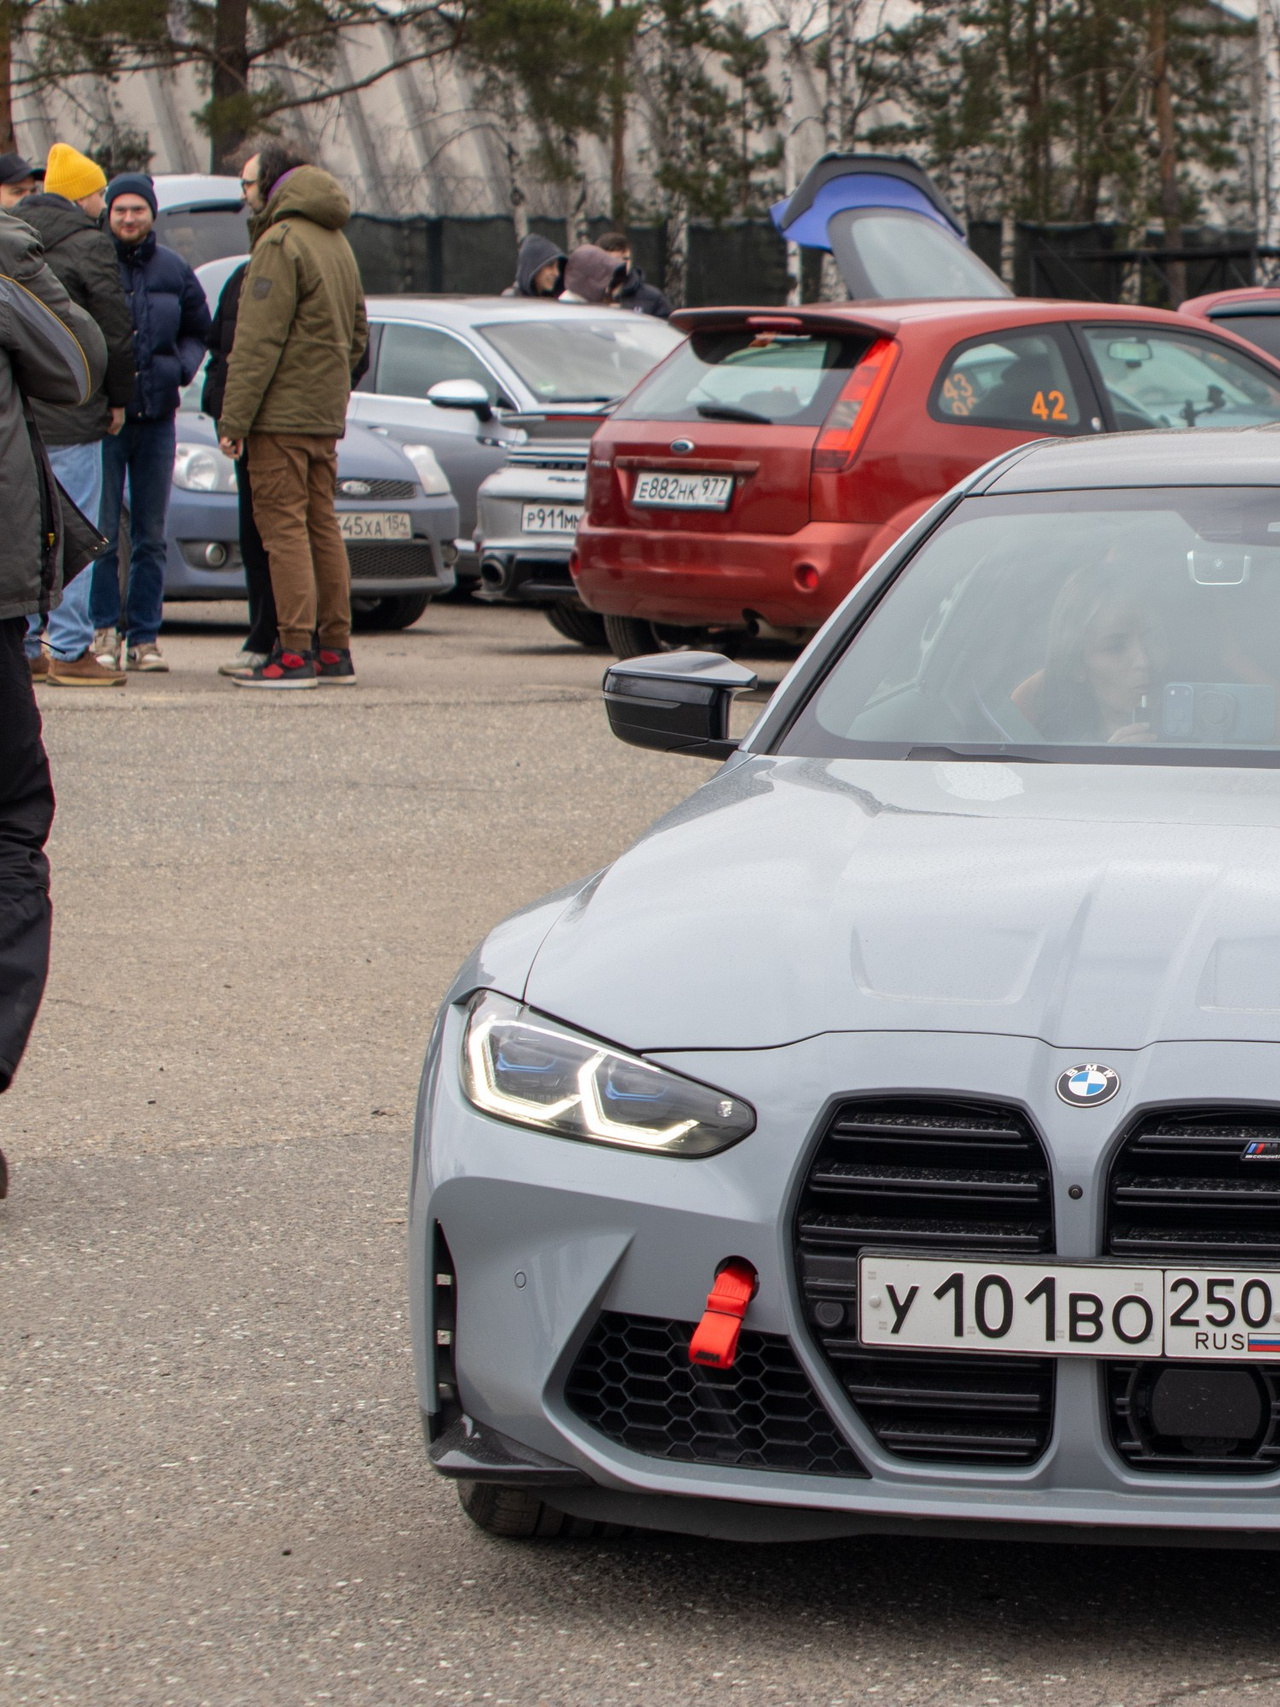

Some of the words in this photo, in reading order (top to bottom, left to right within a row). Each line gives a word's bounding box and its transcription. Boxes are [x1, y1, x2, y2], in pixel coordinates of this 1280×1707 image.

[1031, 390, 1068, 420] 42
[638, 477, 698, 501] Е882НК
[702, 477, 728, 497] 977
[337, 515, 383, 536] 45ХА
[385, 514, 408, 531] 154
[1065, 1064, 1116, 1078] BMW
[885, 1272, 1154, 1345] У101ВО
[1169, 1277, 1273, 1328] 250
[1194, 1332, 1246, 1351] RUS
